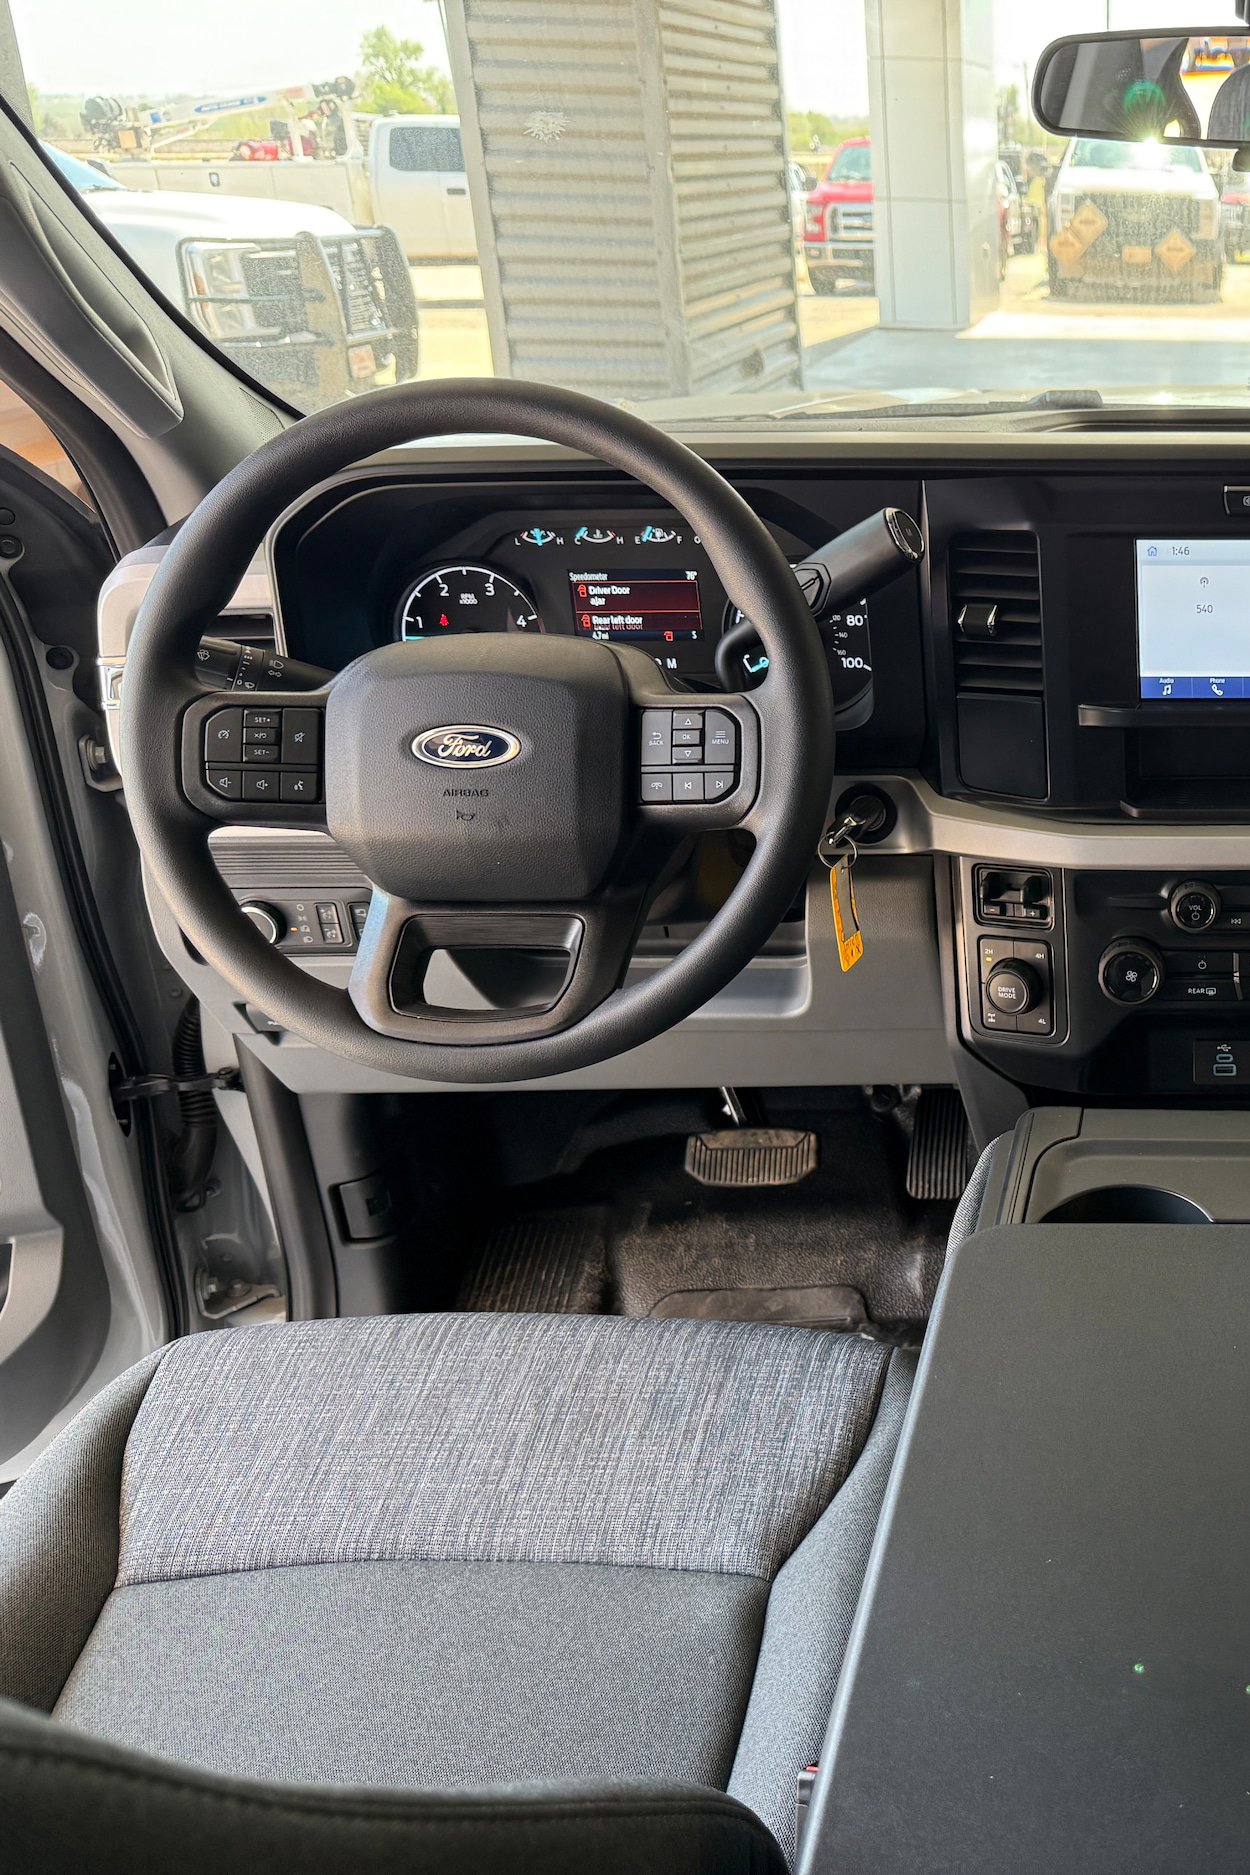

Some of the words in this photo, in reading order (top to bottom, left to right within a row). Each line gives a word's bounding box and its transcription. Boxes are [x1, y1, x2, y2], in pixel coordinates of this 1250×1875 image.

[556, 537, 564, 545] H
[677, 536, 682, 544] F
[1171, 546, 1190, 556] 1:46
[569, 572, 608, 581] Speedometer
[439, 584, 449, 596] 2
[484, 583, 495, 596] 3
[588, 586, 611, 594] Driver
[612, 586, 630, 594] Door
[590, 597, 606, 606] ajar
[1196, 604, 1213, 614] 540
[416, 616, 423, 629] 1
[516, 615, 527, 627] 4
[592, 615, 610, 624] Rear
[611, 615, 625, 624] left
[625, 615, 643, 624] door
[846, 614, 864, 626] 80
[666, 658, 677, 669] M
[841, 657, 863, 669] 100
[437, 733, 493, 758] Ford
[443, 789, 489, 797] AIRBAG
